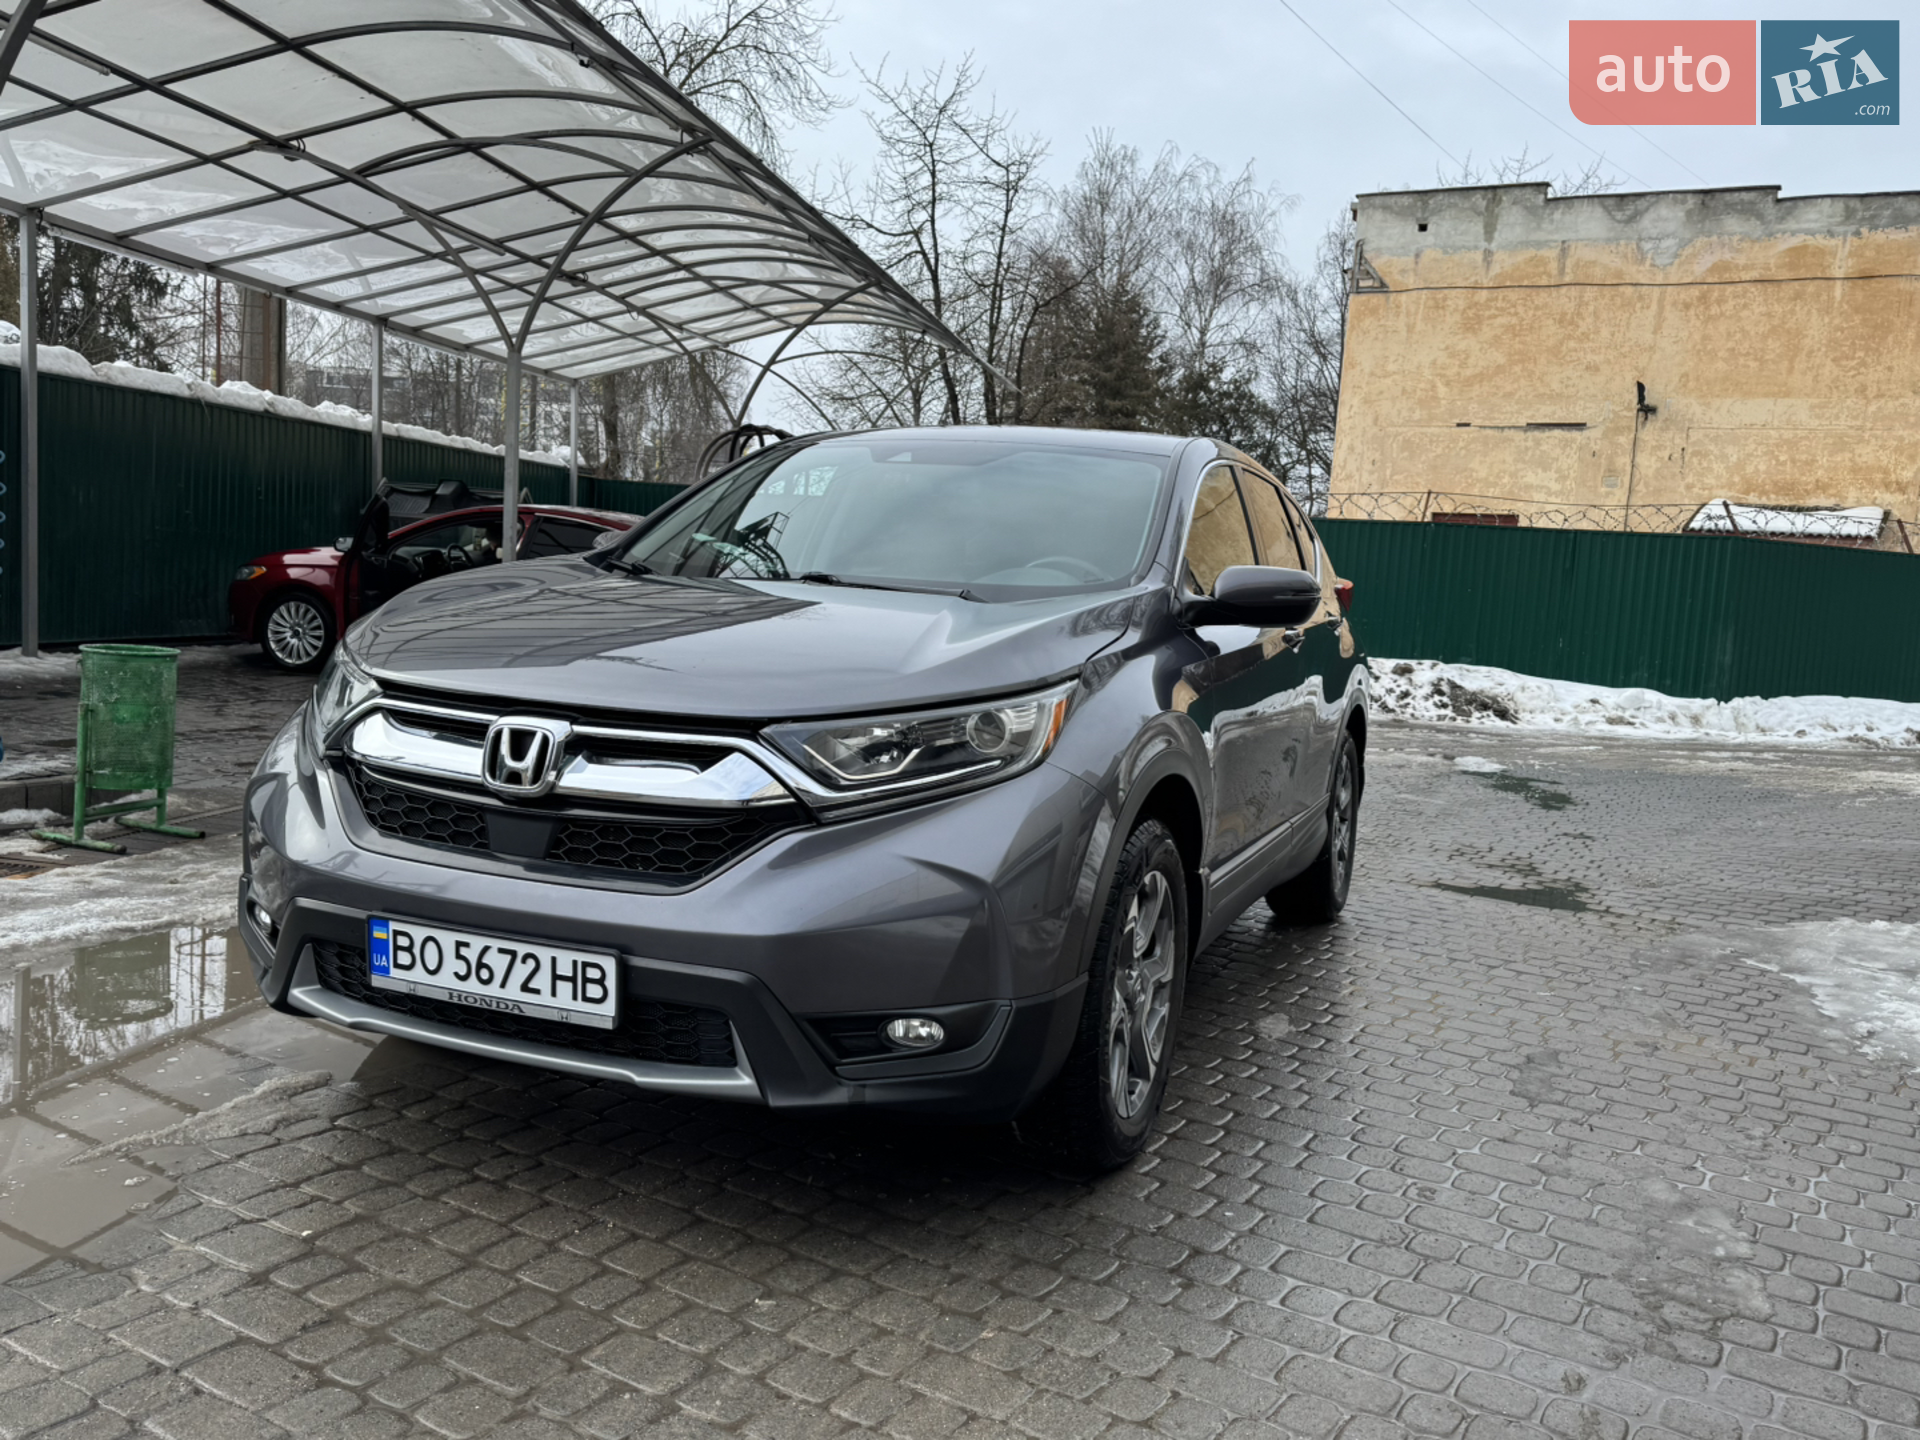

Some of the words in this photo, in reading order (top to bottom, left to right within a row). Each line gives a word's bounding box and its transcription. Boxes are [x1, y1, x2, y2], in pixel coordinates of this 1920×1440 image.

[373, 954, 388, 967] UA
[453, 939, 541, 995] 5672
[447, 991, 526, 1014] HONDA
